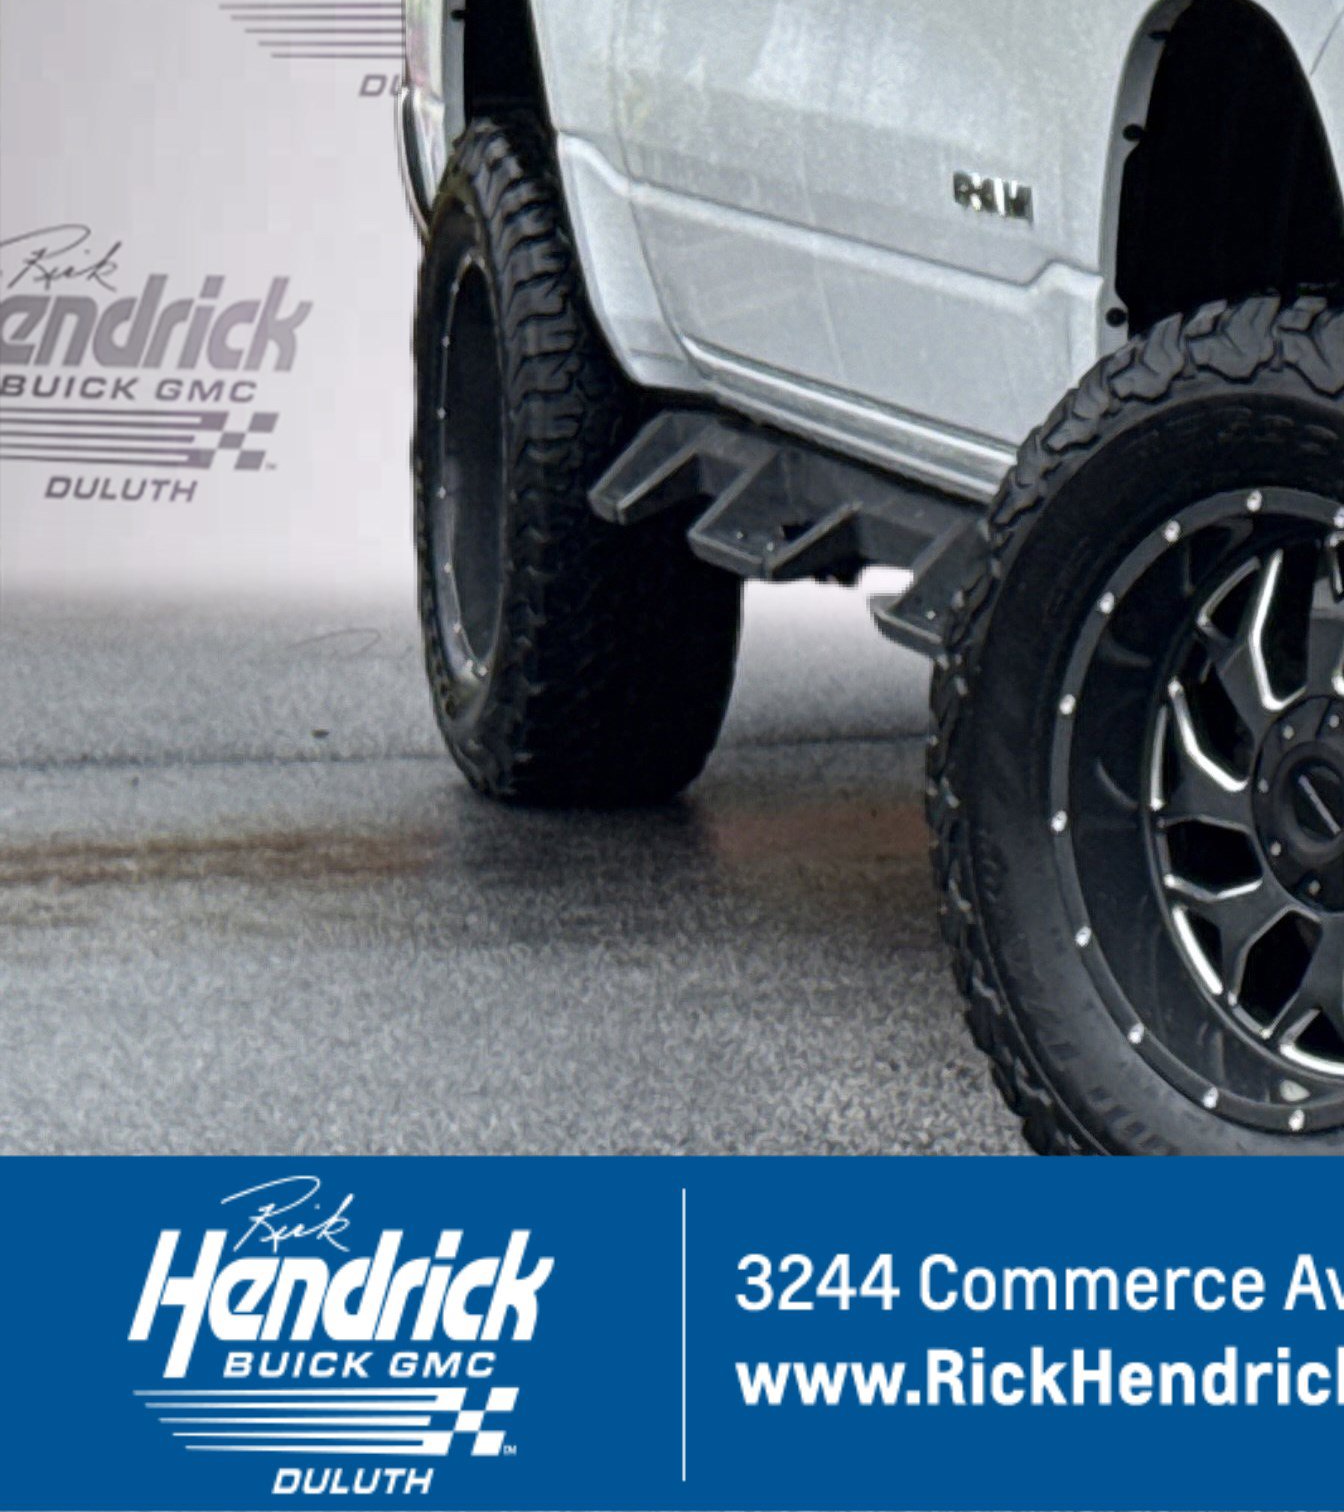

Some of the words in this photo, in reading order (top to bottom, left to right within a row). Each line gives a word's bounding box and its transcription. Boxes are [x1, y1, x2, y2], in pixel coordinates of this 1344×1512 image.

[0, 274, 313, 372] endrick
[1, 374, 139, 400] BUICK
[154, 378, 258, 403] GMC
[44, 476, 198, 503] DULUTH
